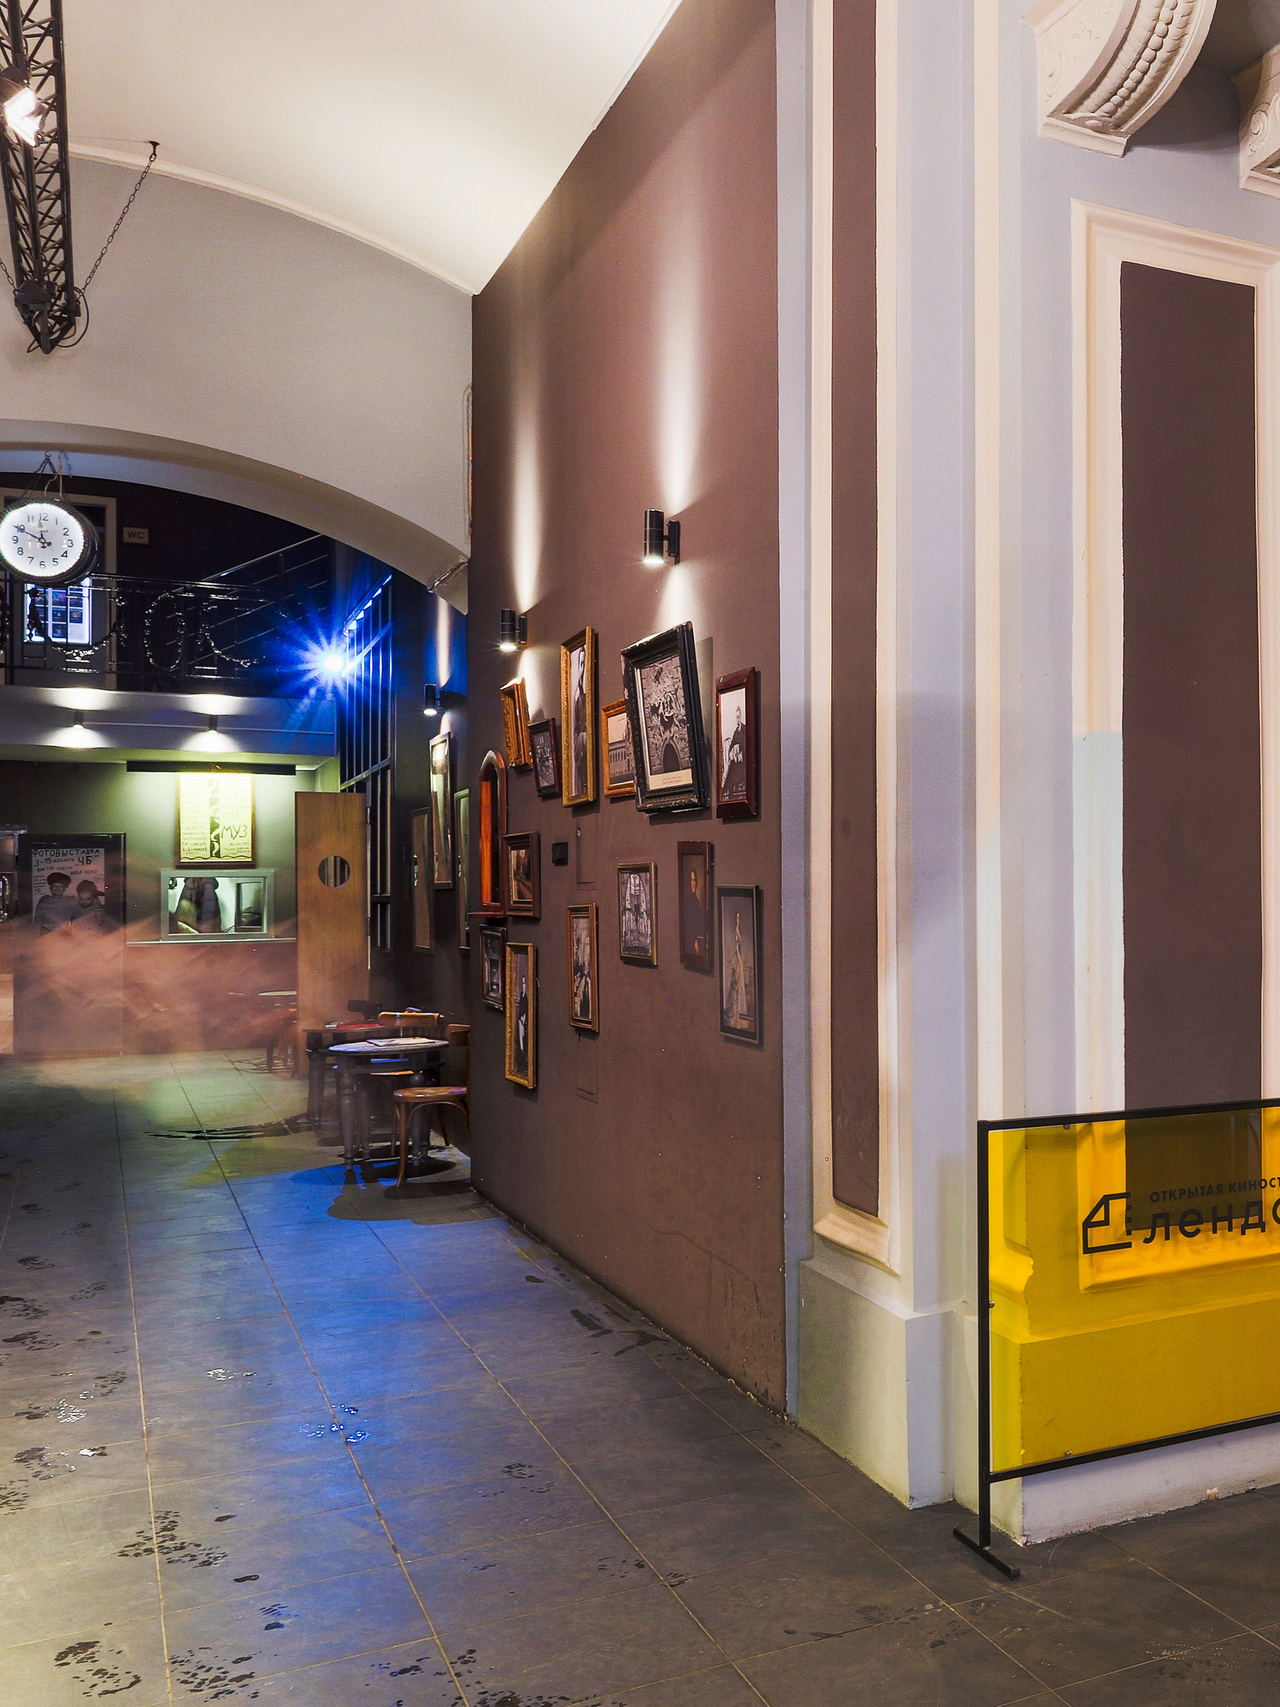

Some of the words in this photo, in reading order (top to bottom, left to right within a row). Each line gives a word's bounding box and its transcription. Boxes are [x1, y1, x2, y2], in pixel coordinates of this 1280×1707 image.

[27, 515, 35, 523] 11
[39, 512, 49, 521] 12
[63, 527, 69, 536] 2
[128, 531, 145, 540] WC
[12, 535, 19, 544] 9
[67, 539, 74, 548] 3
[17, 547, 24, 556] 8
[61, 550, 68, 558] 4
[28, 556, 34, 565] 7
[39, 561, 46, 569] 6
[52, 558, 59, 566] 5
[221, 824, 248, 840] МУЗ
[32, 848, 100, 857] ФОТОВЫСТАВКА
[1150, 1184, 1224, 1203] ОТКРЫТАЯ
